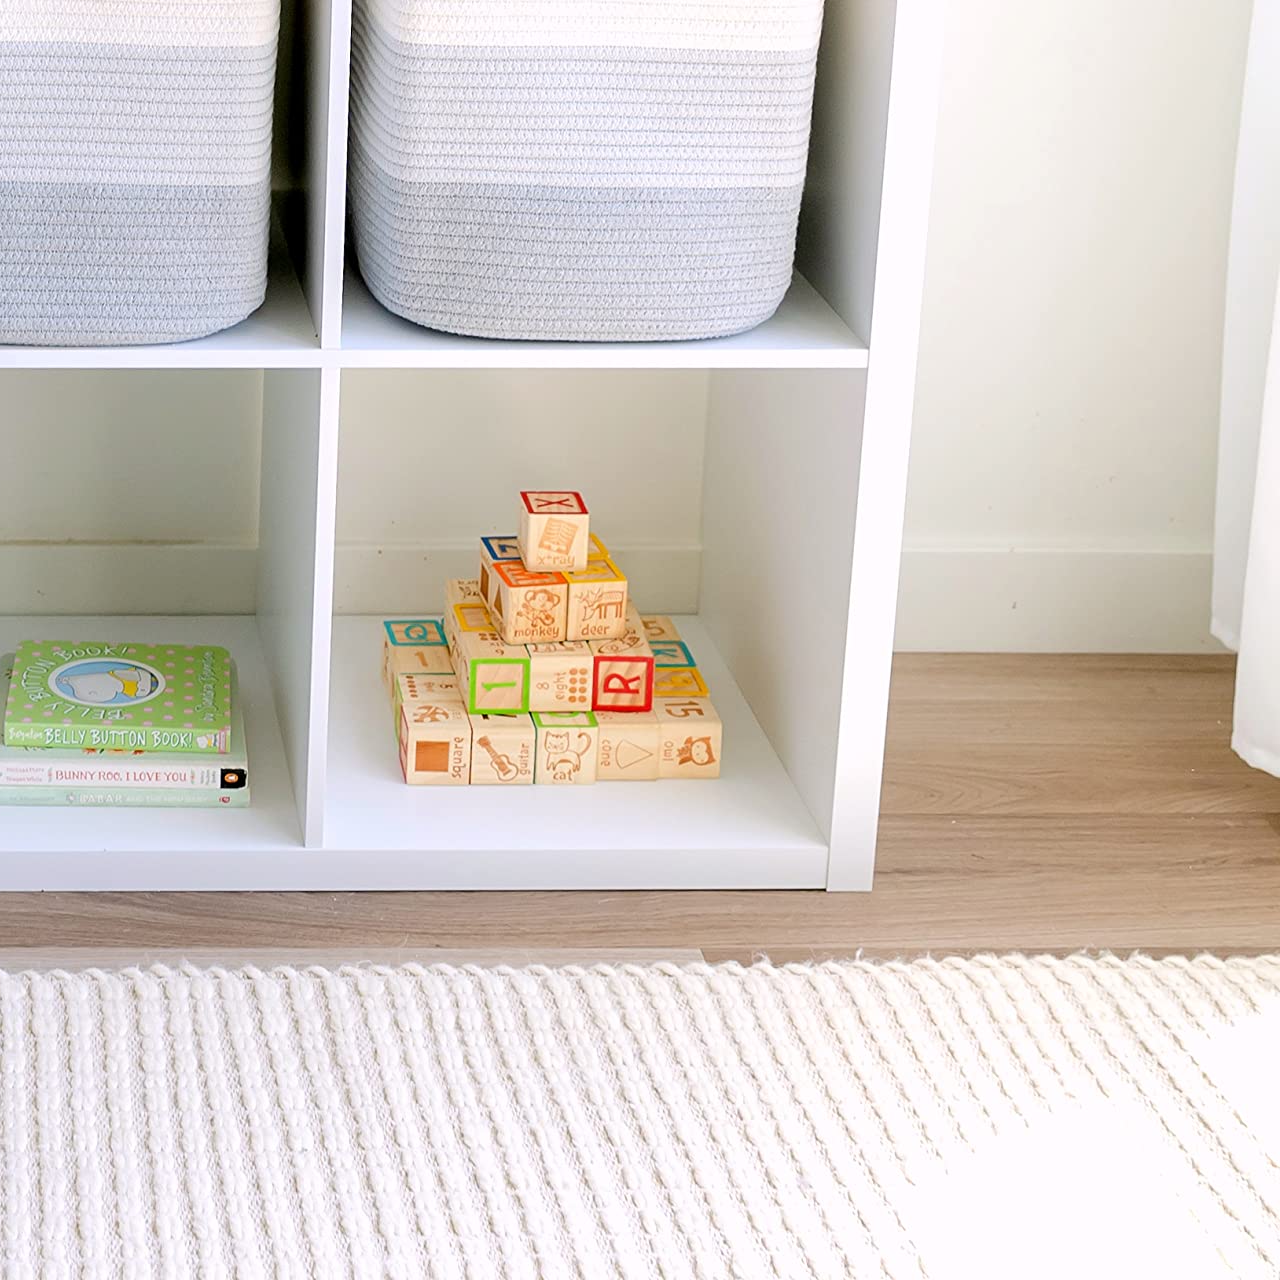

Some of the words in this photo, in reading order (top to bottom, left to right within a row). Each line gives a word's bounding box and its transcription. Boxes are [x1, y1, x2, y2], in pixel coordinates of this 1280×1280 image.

[535, 498, 574, 508] X
[404, 623, 428, 641] Q
[514, 623, 560, 638] monkey
[581, 623, 610, 636] deer
[54, 646, 129, 662] BOOK!
[21, 658, 56, 702] BUTTON
[482, 681, 517, 692] 1
[536, 681, 550, 690] 8
[553, 670, 568, 700] eight
[603, 673, 641, 694] R
[43, 700, 128, 720] BELLY
[664, 700, 705, 718] 15
[8, 727, 44, 741] Boynton
[43, 727, 86, 746] BELLY
[89, 728, 147, 747] BUTTON
[151, 729, 194, 748] BOOK!
[452, 736, 467, 778] square
[520, 742, 530, 776] guitar
[600, 739, 613, 767] cone
[663, 740, 674, 761] owl
[55, 770, 95, 781] BUNNY
[125, 771, 130, 782] I
[131, 771, 161, 782] LOVE
[164, 771, 187, 783] YOU
[552, 769, 574, 782] cat
[79, 794, 122, 803] BABAR
